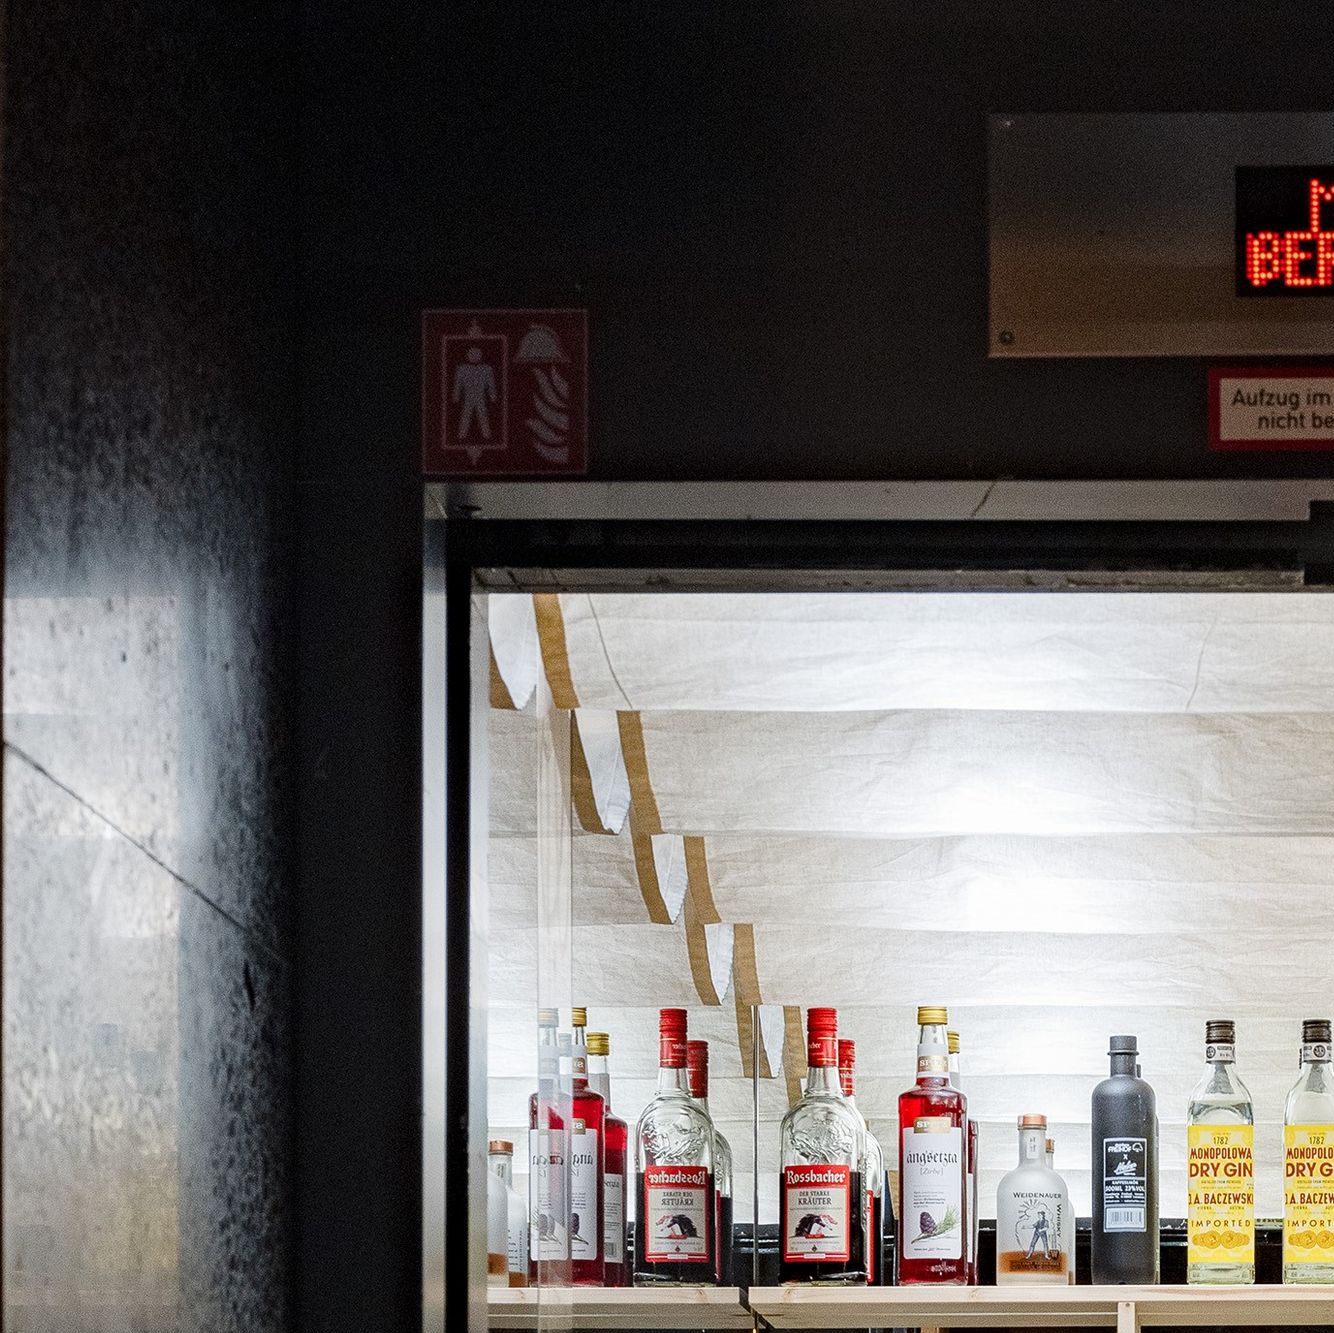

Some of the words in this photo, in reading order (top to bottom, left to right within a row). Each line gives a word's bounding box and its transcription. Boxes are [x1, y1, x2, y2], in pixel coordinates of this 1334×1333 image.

[1232, 388, 1299, 410] Aufzug
[1306, 388, 1331, 406] im
[1258, 412, 1305, 429] nicht
[1213, 1136, 1229, 1145] 1782
[1309, 1136, 1325, 1145] 1782
[1190, 1147, 1253, 1159] MONOPOLOWA
[1189, 1162, 1221, 1178] DRY
[1224, 1162, 1253, 1178] GIN
[1286, 1162, 1317, 1178] DRY
[787, 1170, 846, 1184] Rossbacher
[798, 1197, 832, 1206] KRÄUTER
[1204, 1193, 1254, 1205] BACZEWSKI
[1191, 1219, 1251, 1227] IMPORTED
